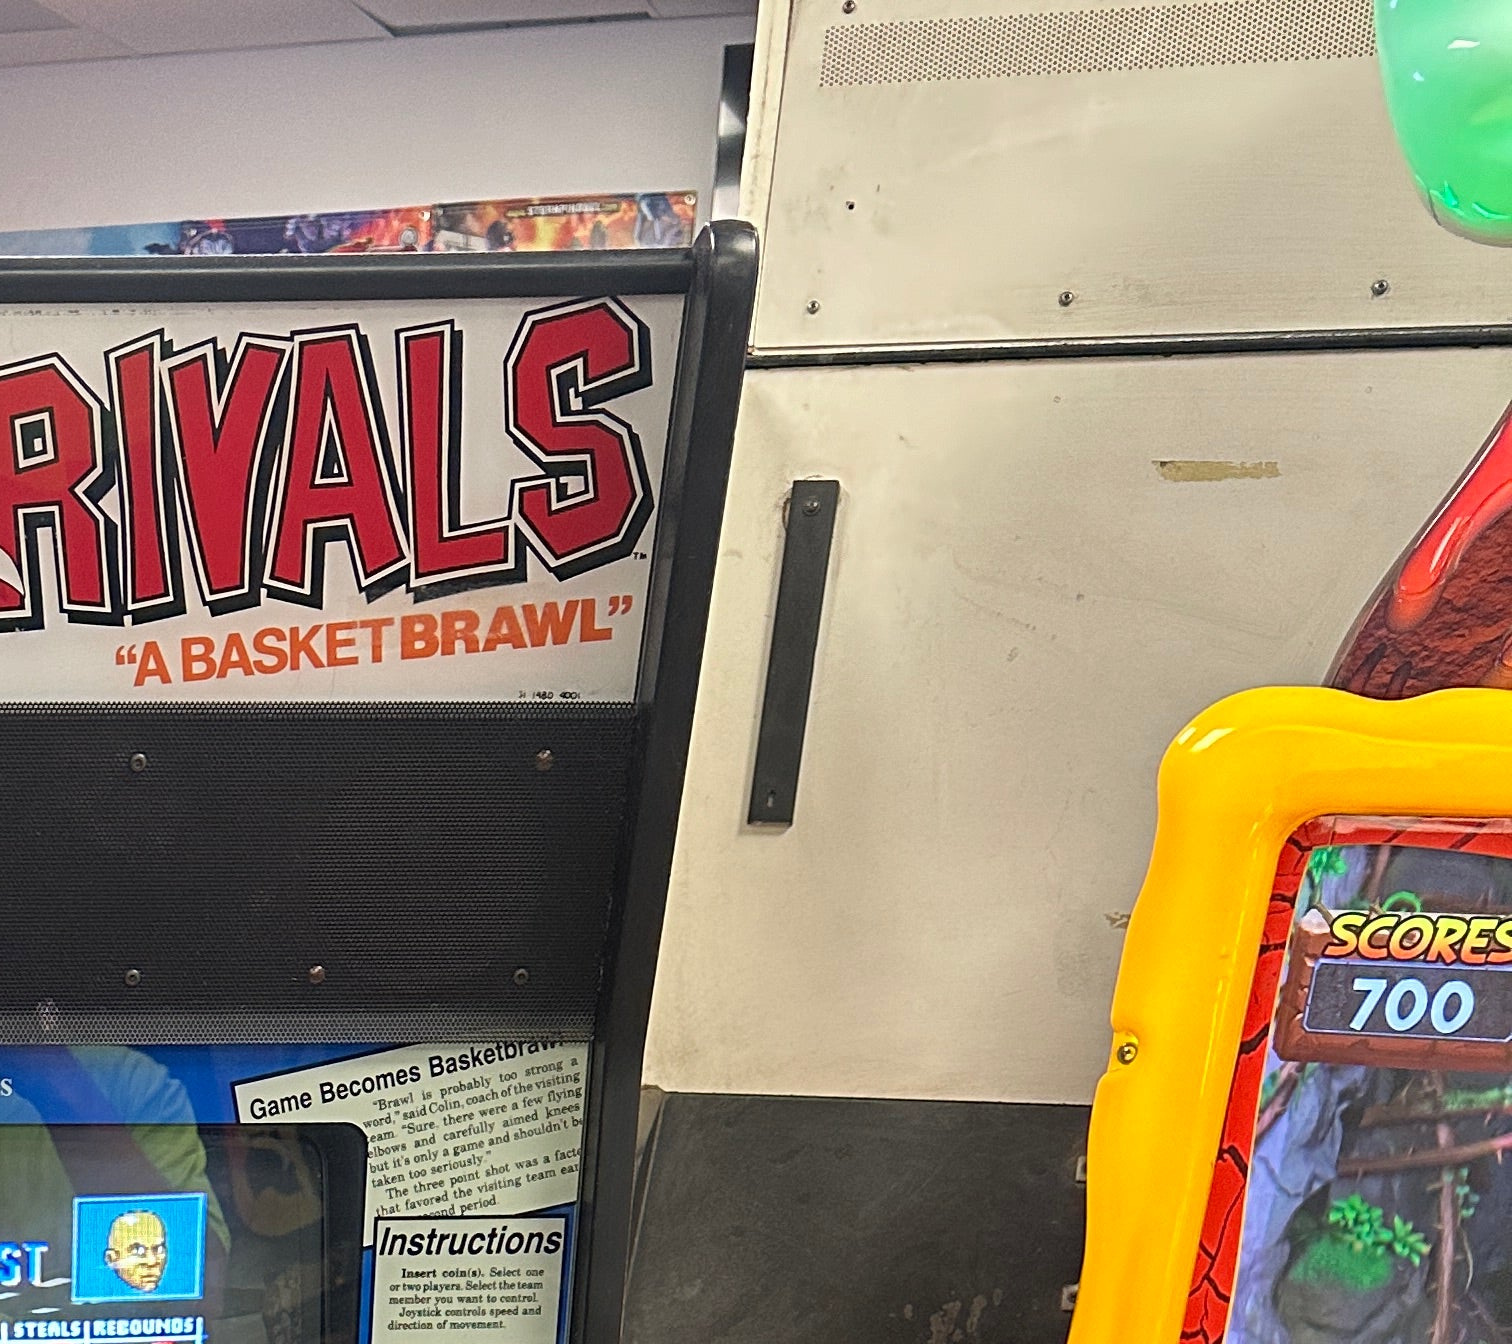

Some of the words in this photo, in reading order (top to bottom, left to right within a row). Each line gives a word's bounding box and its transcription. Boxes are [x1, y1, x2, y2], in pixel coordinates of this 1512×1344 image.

[1349, 977, 1475, 1034] 700
[250, 1092, 313, 1121] Game
[319, 1064, 422, 1104] Becomes
[379, 1226, 563, 1256] Instructions
[13, 1320, 81, 1337] STEALS
[93, 1317, 194, 1337] REBOUNDS
